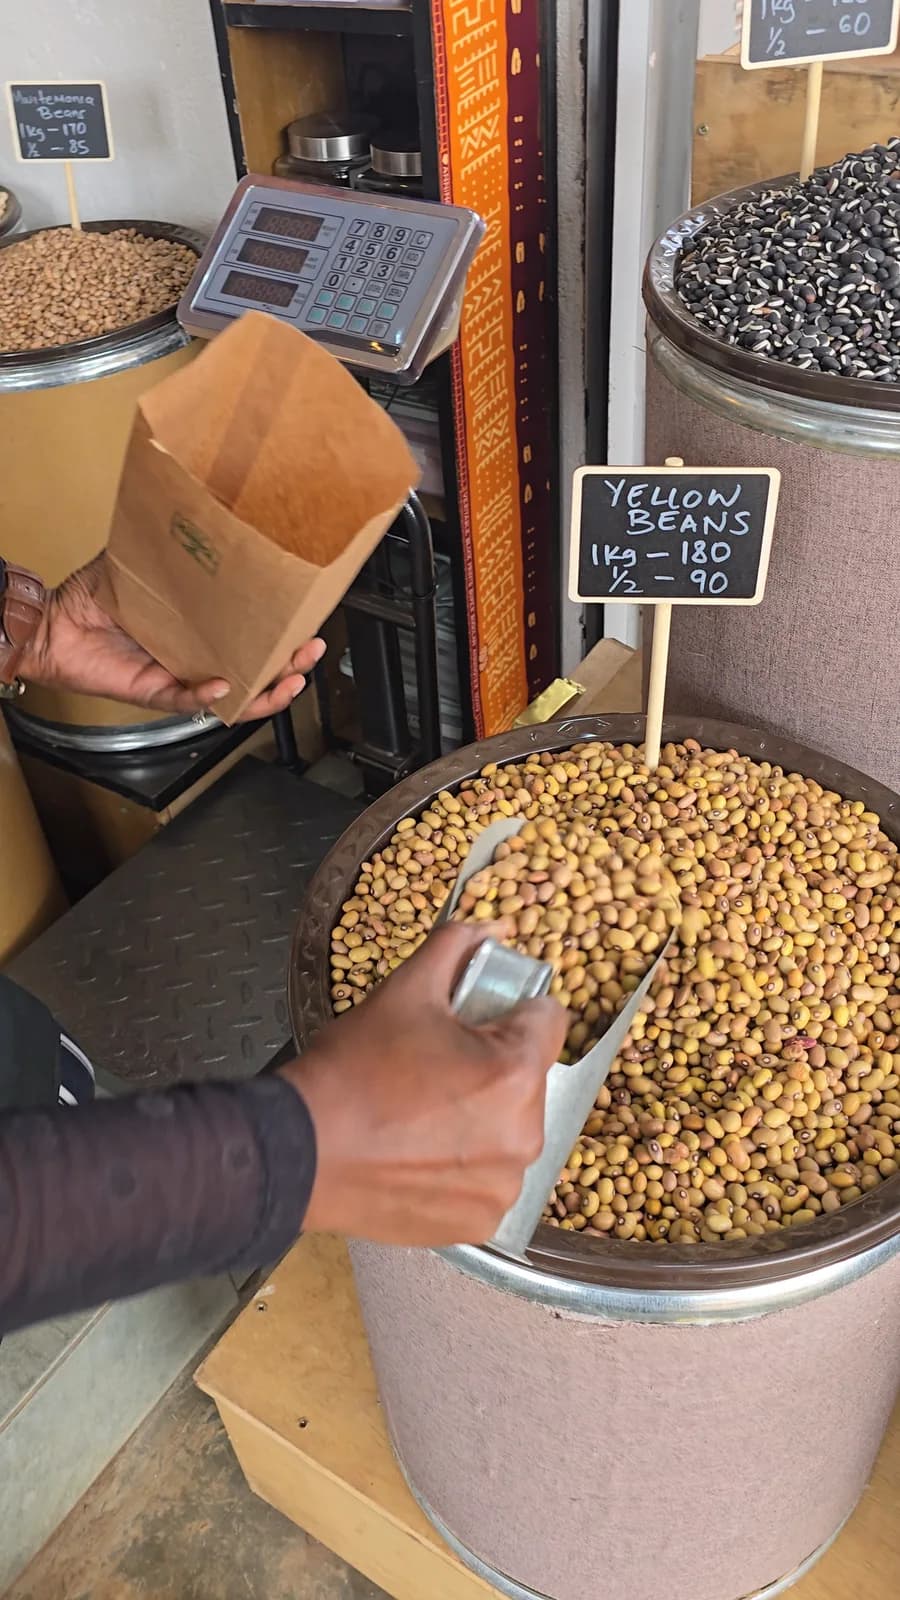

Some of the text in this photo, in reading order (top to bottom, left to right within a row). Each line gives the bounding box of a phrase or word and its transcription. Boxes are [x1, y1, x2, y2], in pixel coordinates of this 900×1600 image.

[839, 12, 871, 36] 60
[62, 121, 87, 136] 170
[69, 139, 90, 155] 85
[354, 221, 366, 234] 7
[374, 225, 385, 238] 8
[394, 229, 406, 242] 9
[345, 240, 356, 252] 4
[365, 243, 376, 256] 5
[386, 247, 398, 260] 6
[339, 257, 348, 270] 1
[356, 261, 369, 274] 2
[377, 264, 389, 277] 3
[328, 274, 340, 287] 0
[604, 478, 743, 510] YELLOW
[626, 509, 751, 536] BEANS
[681, 540, 732, 565] 180
[690, 569, 729, 594] 90
